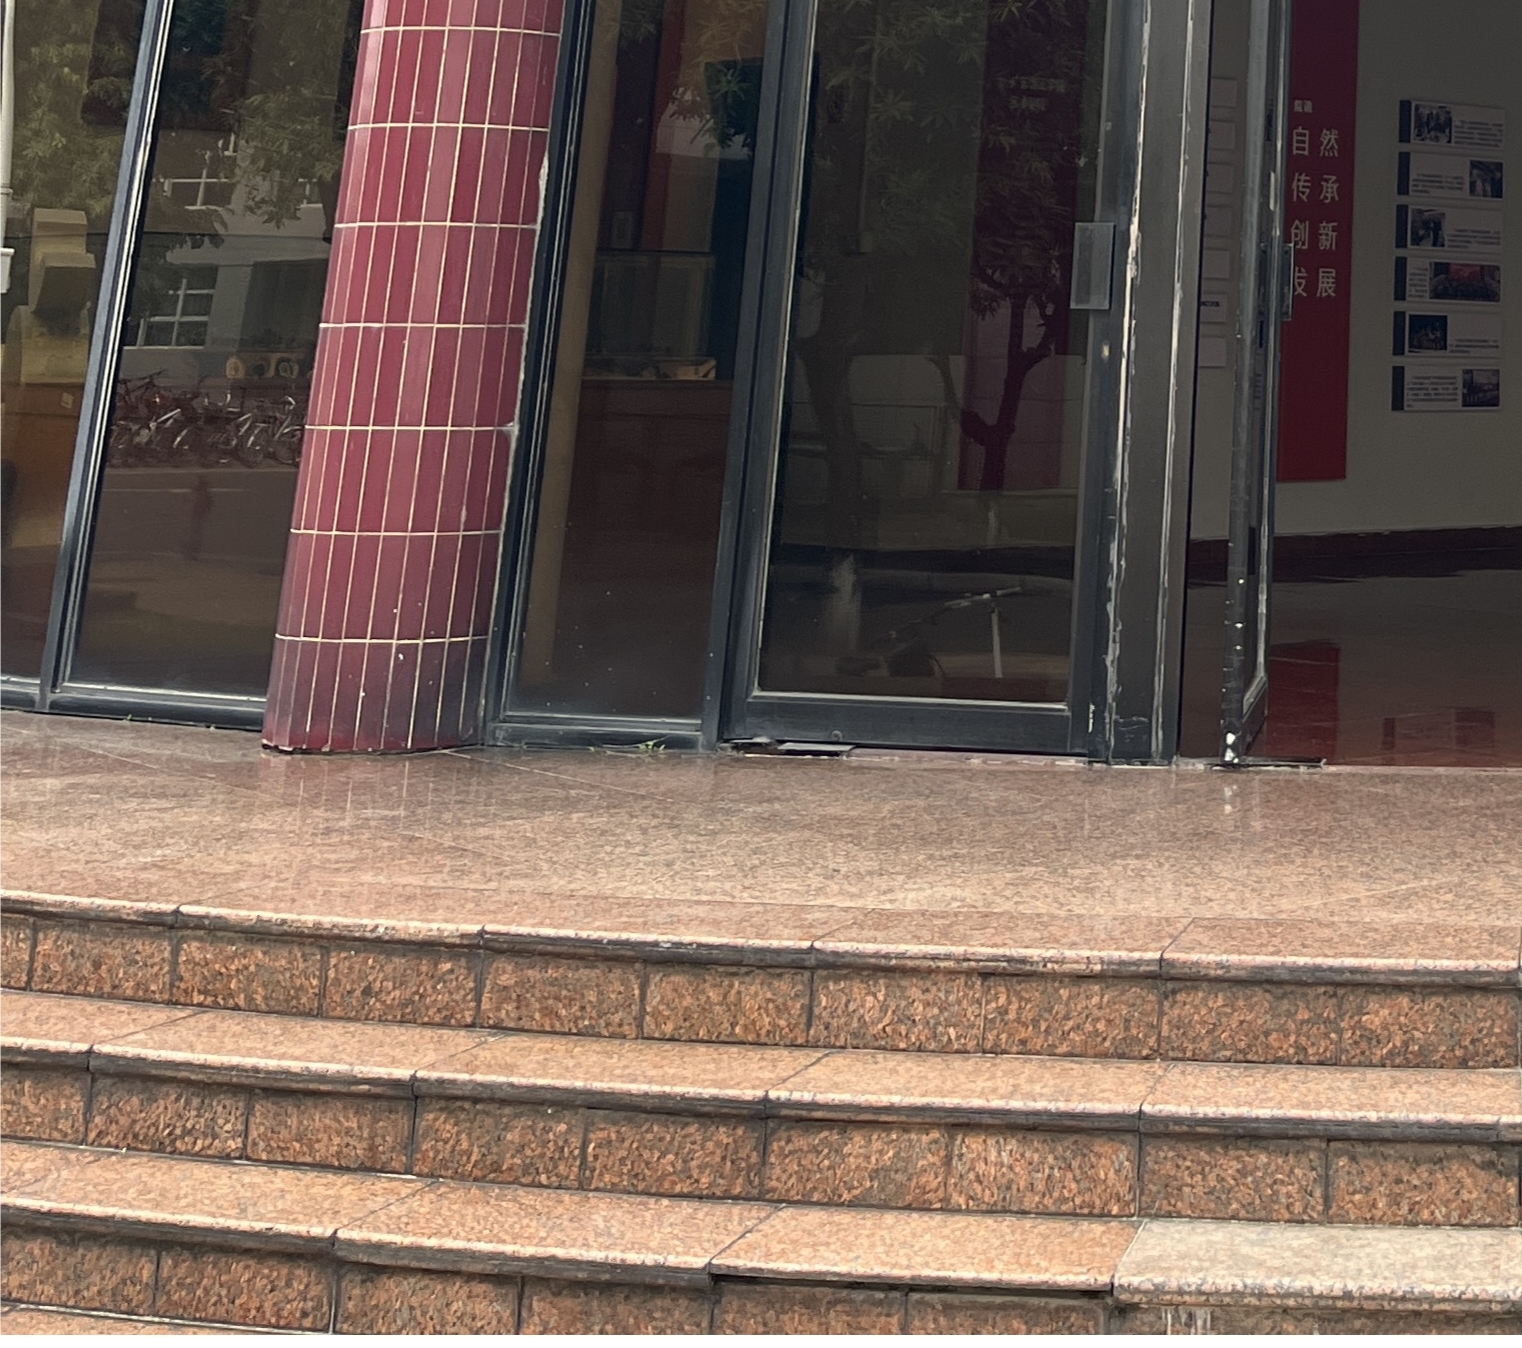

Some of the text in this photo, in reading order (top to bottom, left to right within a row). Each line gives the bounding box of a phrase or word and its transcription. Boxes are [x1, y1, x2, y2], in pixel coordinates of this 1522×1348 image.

[1292, 126, 1339, 157] 自然
[1291, 172, 1339, 203] 传承
[1290, 219, 1338, 250] 创新
[1293, 267, 1337, 298] 发展
